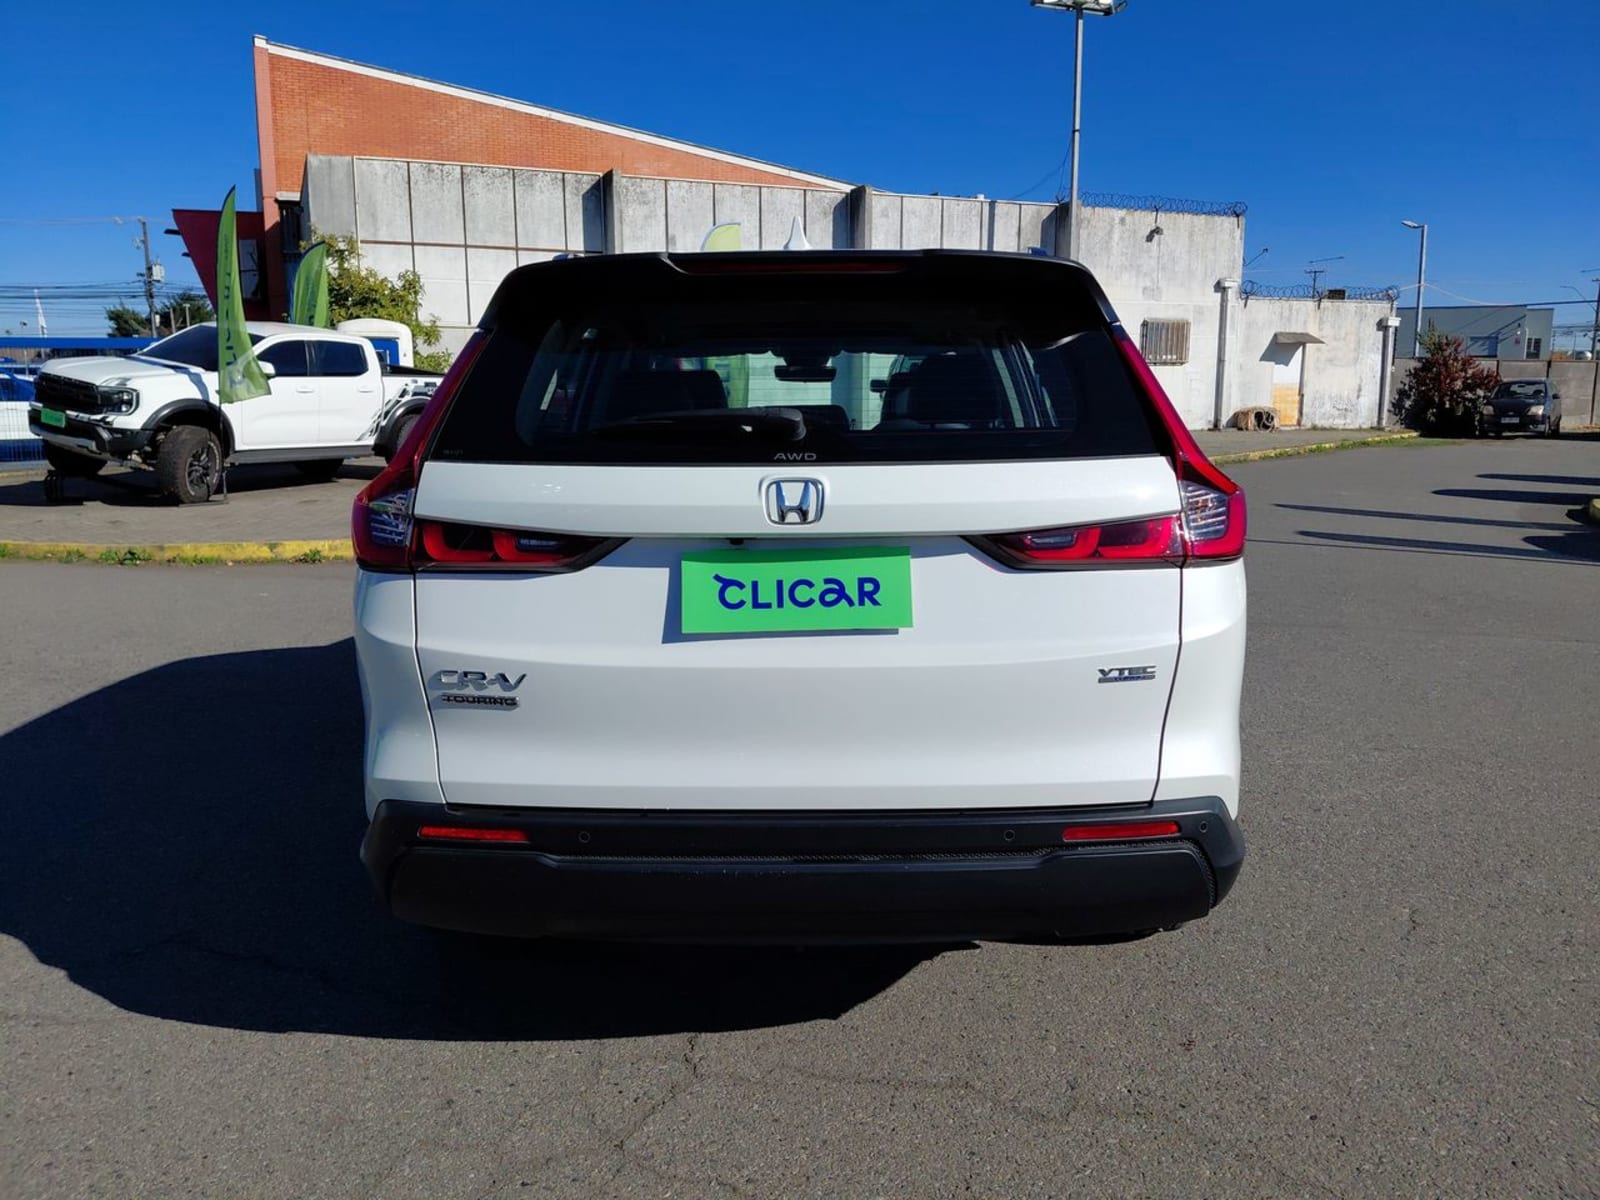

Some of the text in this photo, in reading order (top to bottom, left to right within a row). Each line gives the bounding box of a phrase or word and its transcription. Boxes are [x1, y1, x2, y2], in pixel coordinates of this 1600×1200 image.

[773, 452, 817, 461] AWD
[1097, 665, 1157, 677] VTEC
[439, 693, 519, 707] TOURING
